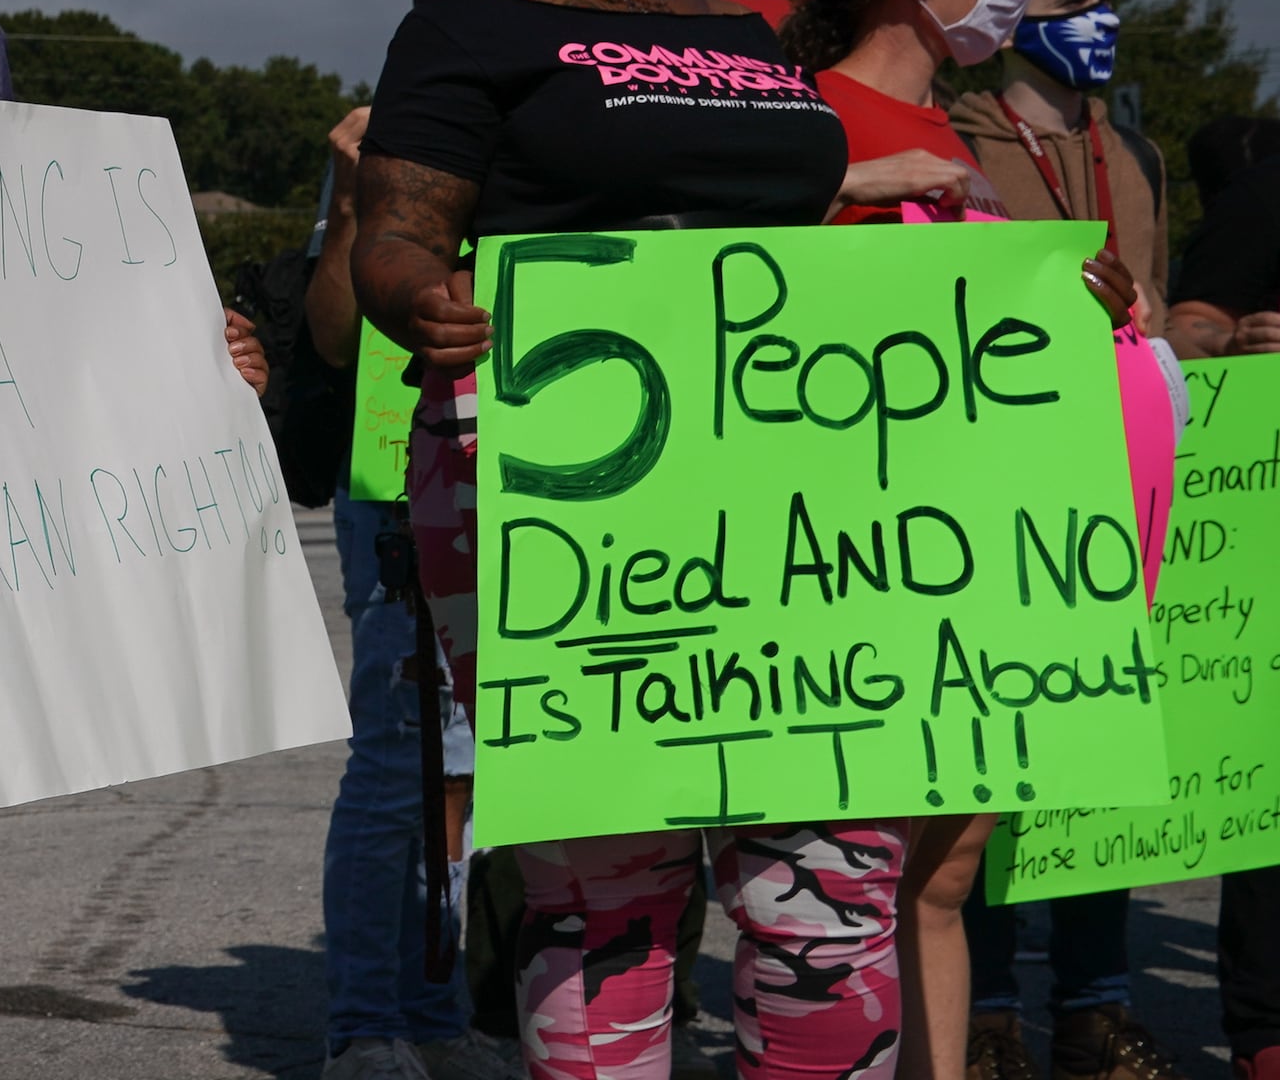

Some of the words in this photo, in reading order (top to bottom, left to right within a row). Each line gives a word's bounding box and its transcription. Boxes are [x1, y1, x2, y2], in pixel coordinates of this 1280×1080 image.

[604, 93, 696, 109] EMPOWERING
[698, 97, 747, 110] DIGNITY
[750, 99, 810, 110] THROUGH
[103, 166, 177, 267] IS
[492, 233, 673, 502] 5
[711, 241, 1061, 490] People
[497, 509, 751, 640] Died
[779, 491, 976, 612] AND
[1014, 506, 1139, 610] NO
[479, 675, 583, 748] Is
[929, 618, 1153, 718] About
[1181, 653, 1253, 705] During
[1215, 755, 1264, 795] for
[1006, 845, 1077, 886] those
[1093, 809, 1208, 871] unlawfully
